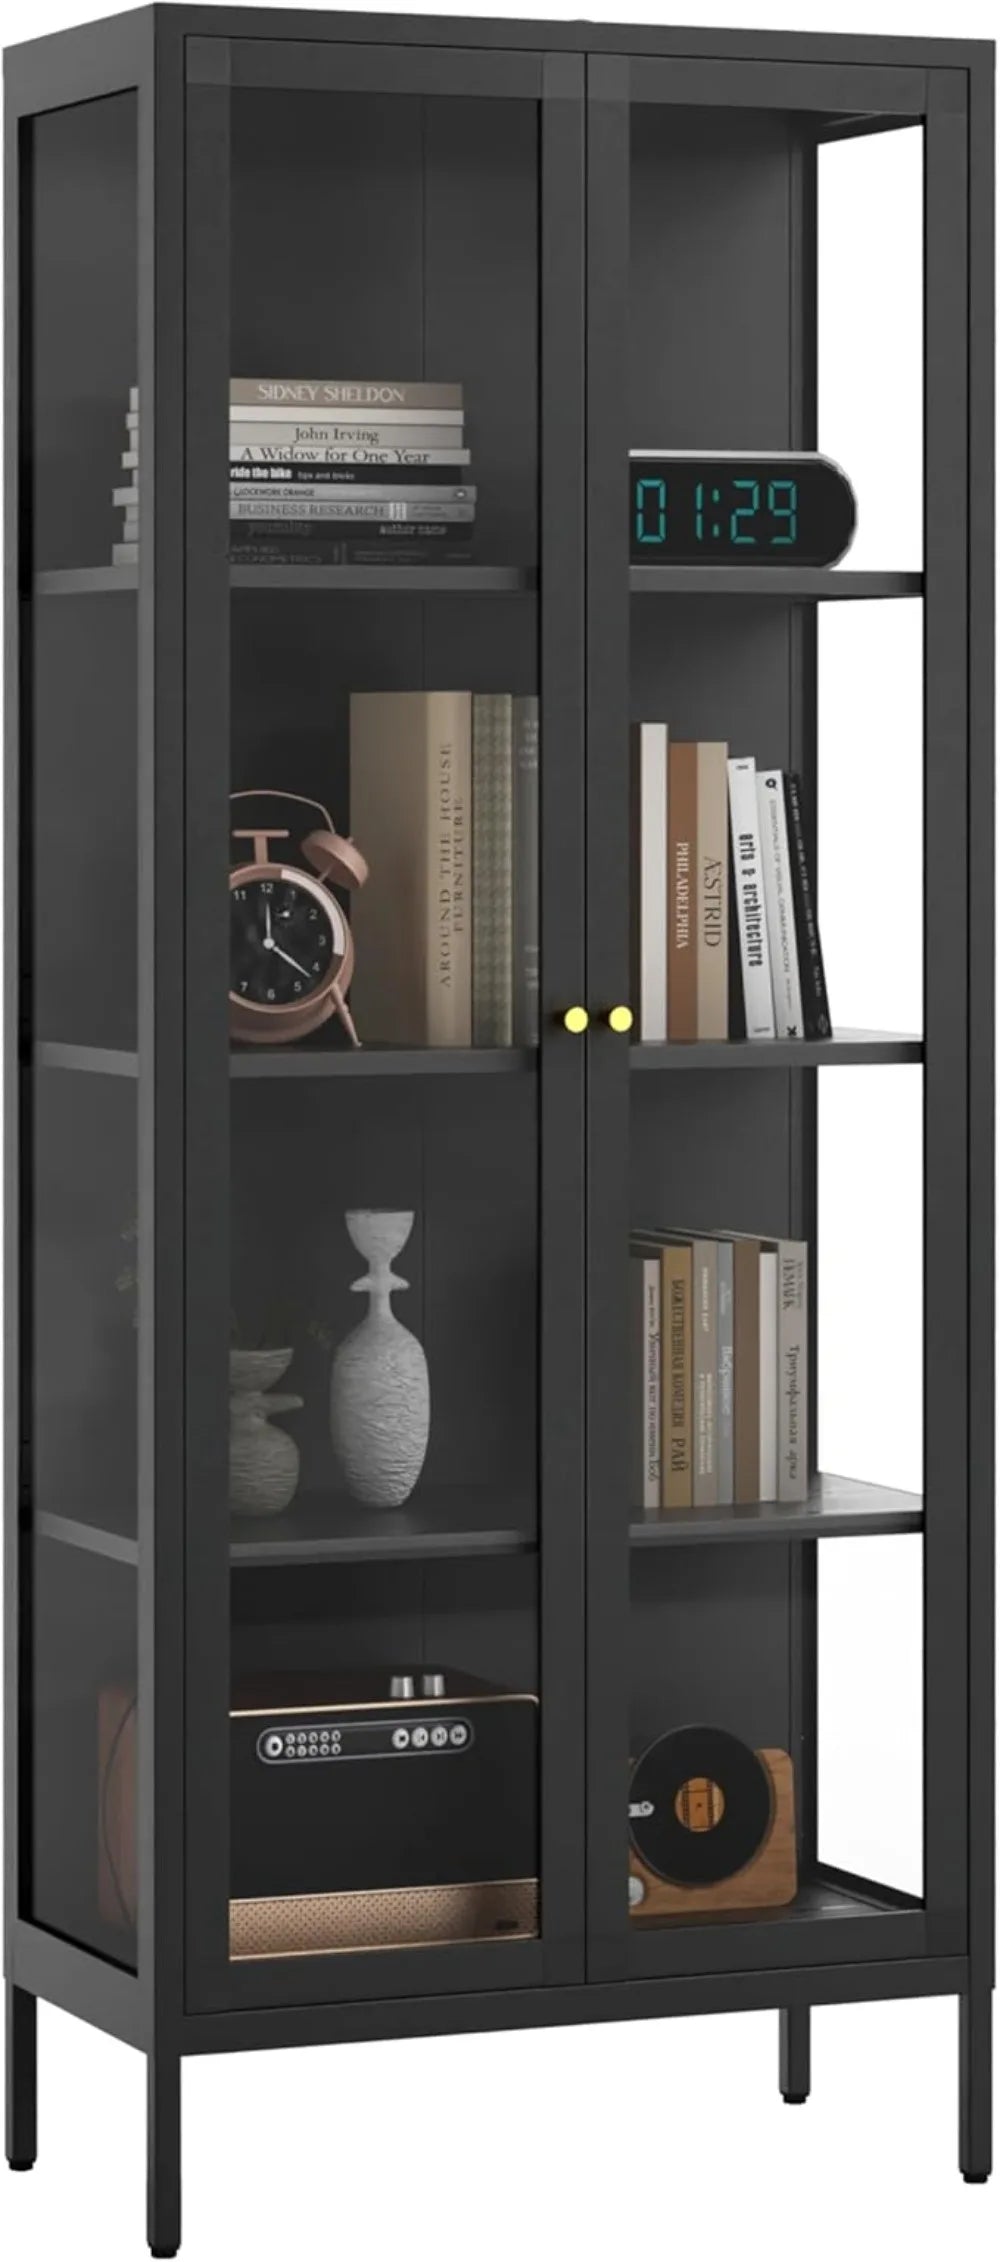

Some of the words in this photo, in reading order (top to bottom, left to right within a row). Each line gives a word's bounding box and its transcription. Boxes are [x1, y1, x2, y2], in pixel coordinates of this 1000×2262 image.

[258, 383, 319, 401] SIDNEY
[324, 385, 406, 403] SHELDON
[293, 426, 328, 443] John
[334, 427, 380, 445] Irving
[240, 447, 254, 461] A
[260, 445, 319, 461] Widow
[325, 446, 347, 462] for
[353, 448, 388, 464] One
[394, 449, 431, 464] Year
[283, 488, 315, 497] ORANGE
[238, 502, 305, 516] BUSINESS
[309, 503, 385, 517] RESEARCH
[636, 479, 797, 544] 01:29
[440, 743, 452, 821] HOUSE
[739, 833, 756, 861] arts
[440, 833, 452, 881] THE
[453, 797, 464, 933] FURNITURE
[234, 890, 246, 901] 11
[260, 883, 274, 894] 12
[676, 841, 690, 949] PHILADELPHIA
[309, 909, 318, 920] 2
[743, 883, 764, 967] architecture
[318, 935, 326, 946] 3
[440, 888, 452, 988] AROUND
[312, 961, 320, 972] 4
[241, 981, 248, 992] 7
[267, 988, 275, 1000] 6
[294, 981, 302, 992] 5
[672, 1279, 686, 1370] БОЖЕСТВЕННАЯ
[672, 1437, 690, 1473] РАЙ
